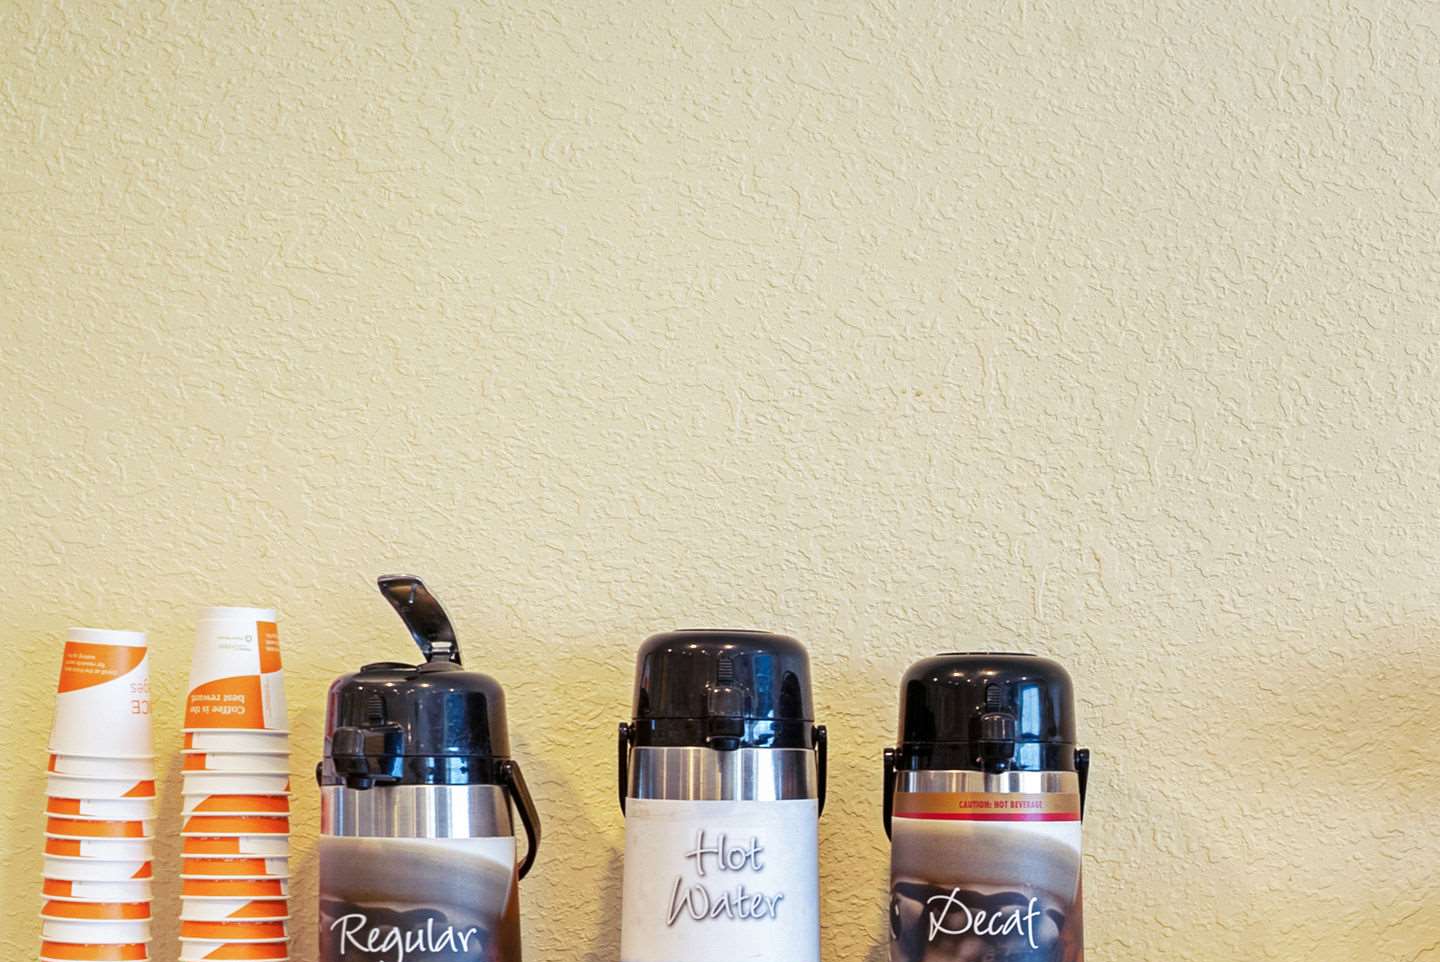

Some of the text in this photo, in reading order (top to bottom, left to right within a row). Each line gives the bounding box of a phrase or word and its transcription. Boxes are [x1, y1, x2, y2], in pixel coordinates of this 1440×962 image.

[211, 705, 246, 715] Coffee
[223, 694, 246, 704] best
[959, 800, 992, 809] CAUTION:
[993, 800, 1008, 809] HOT
[685, 829, 764, 876] Hot
[666, 876, 784, 927] Water
[927, 887, 1041, 949] Decaf
